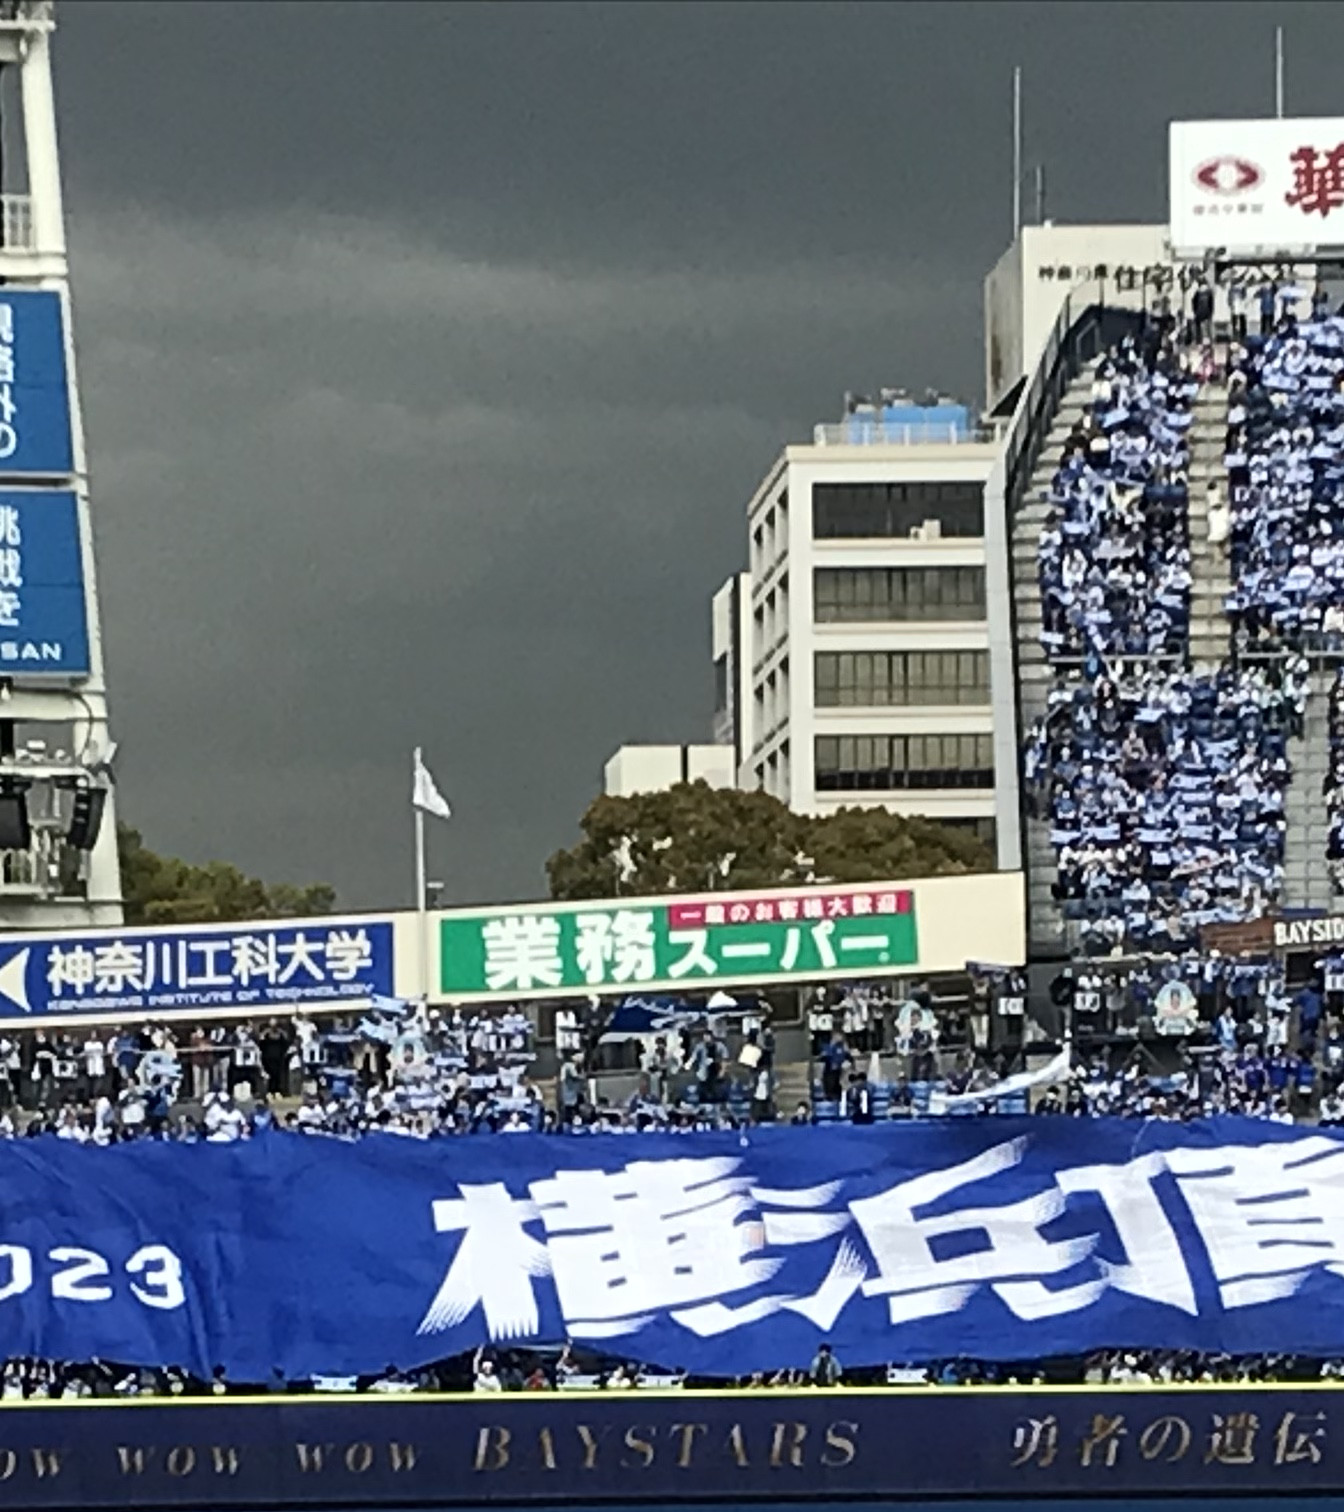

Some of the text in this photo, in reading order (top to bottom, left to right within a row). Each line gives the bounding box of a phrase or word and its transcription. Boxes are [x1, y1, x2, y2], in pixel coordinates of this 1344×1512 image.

[47, 928, 374, 996] 神奈川工科大学
[483, 905, 890, 990] 業務スーパー
[471, 1420, 861, 1472] BAYSTARS
